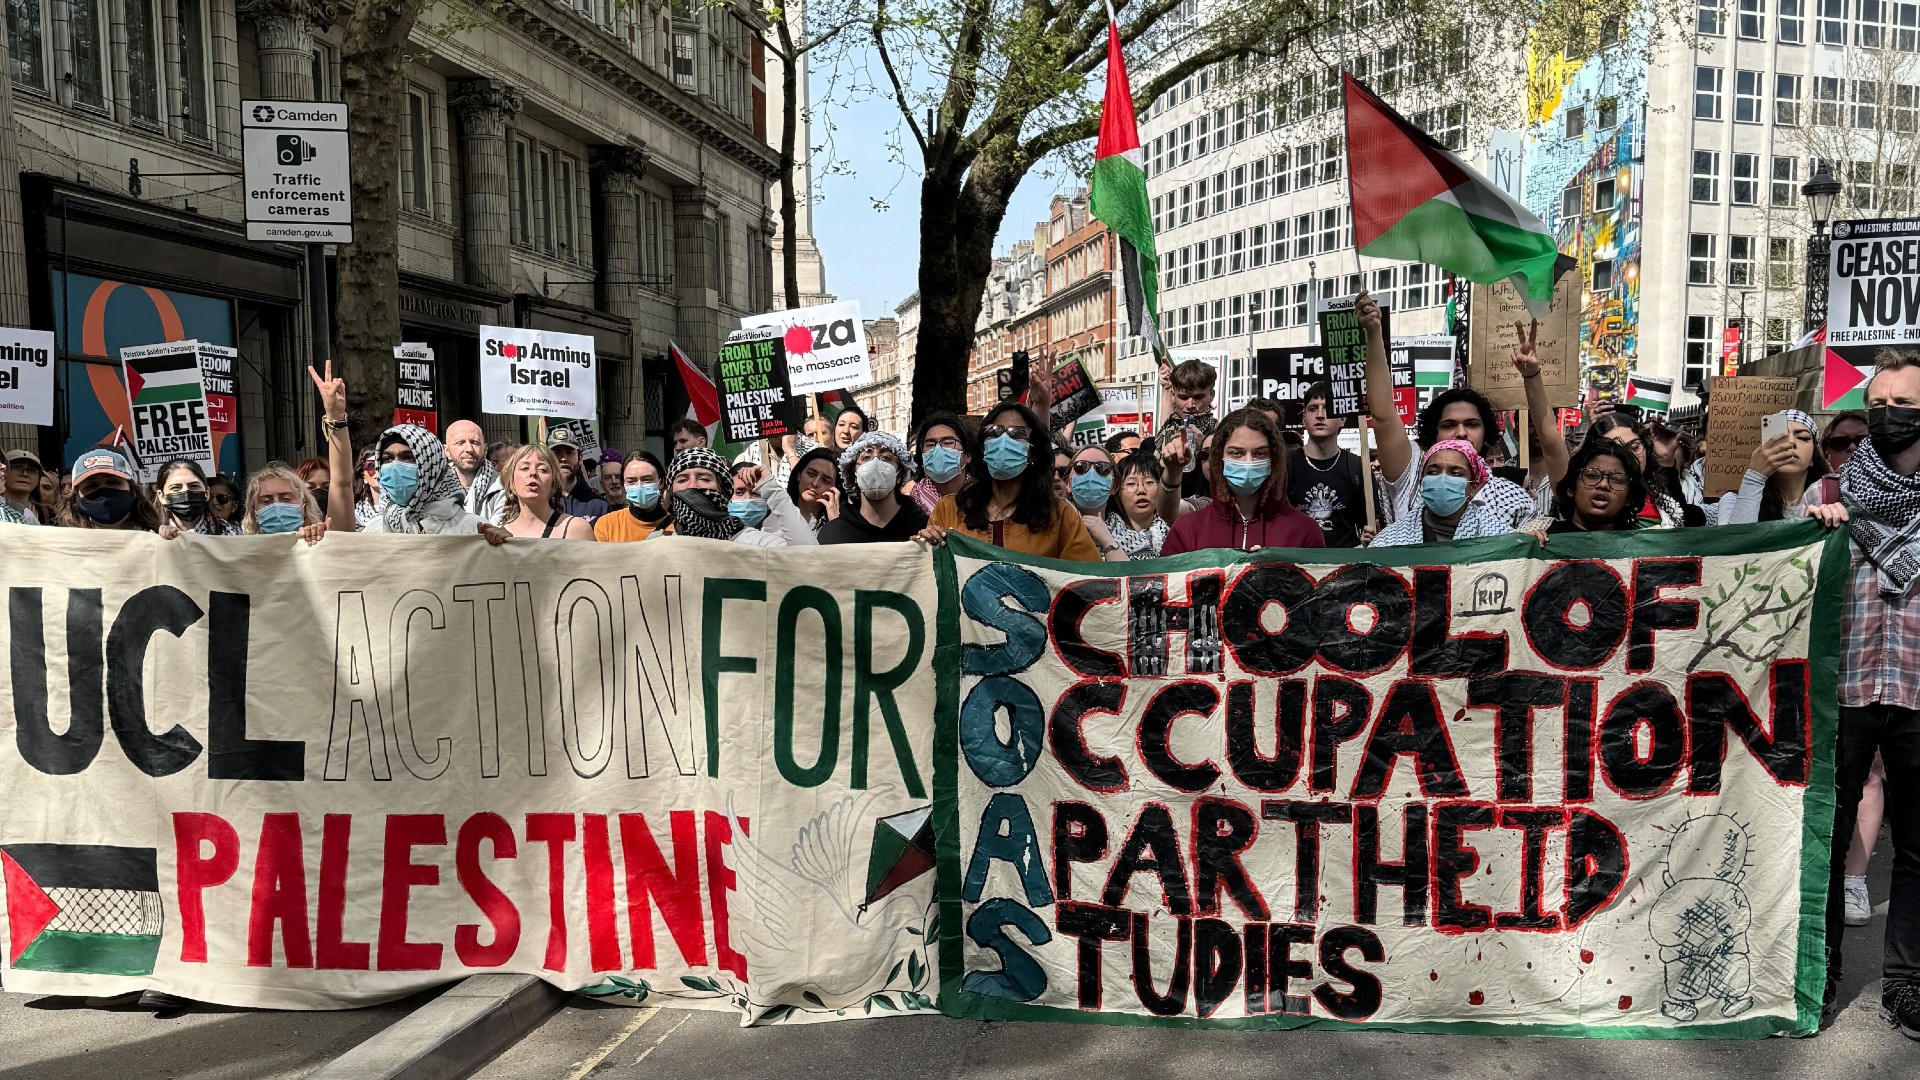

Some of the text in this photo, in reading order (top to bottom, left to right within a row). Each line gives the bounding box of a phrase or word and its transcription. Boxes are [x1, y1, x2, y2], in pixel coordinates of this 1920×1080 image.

[277, 109, 338, 122] Camden
[273, 173, 321, 185] Traffic
[251, 188, 345, 201] enforcement
[268, 205, 330, 216] cameras
[266, 228, 333, 238] camden.gov.uk
[1855, 223, 1891, 234] PALESTINE
[1837, 240, 1920, 278] CEASE
[399, 294, 458, 320] THAMPTON
[1326, 312, 1359, 330] FROM
[1328, 329, 1360, 347] RIVER
[1830, 330, 1851, 342] FREE
[1852, 328, 1896, 341] PALESTINE
[146, 347, 170, 356] Solidarity
[170, 345, 195, 353] Campaign
[485, 339, 591, 368] Stp Arming
[719, 341, 776, 362] FROM THE
[1329, 345, 1367, 364] THE SE
[721, 357, 772, 377] RIVER TO
[788, 354, 861, 374] he massacre
[1058, 360, 1079, 379] OFF
[1330, 362, 1366, 380] PALES
[510, 363, 570, 388] Israel
[723, 374, 770, 393] THE SEA
[1331, 380, 1358, 398] WILL
[1759, 381, 1797, 391] GENOCIDE
[725, 387, 785, 409] PALESTINE
[1333, 397, 1360, 414] FREE
[1743, 393, 1793, 405] MURDERED
[133, 401, 208, 439] FREE
[727, 404, 774, 424] WILL BE
[730, 422, 760, 440] FREE
[138, 434, 210, 455] PALESTINE
[1478, 589, 1504, 606] RIP
[1521, 556, 1703, 674] OF
[8, 573, 929, 800] UCL ACTION FOR
[172, 810, 750, 984] PALESTINE
